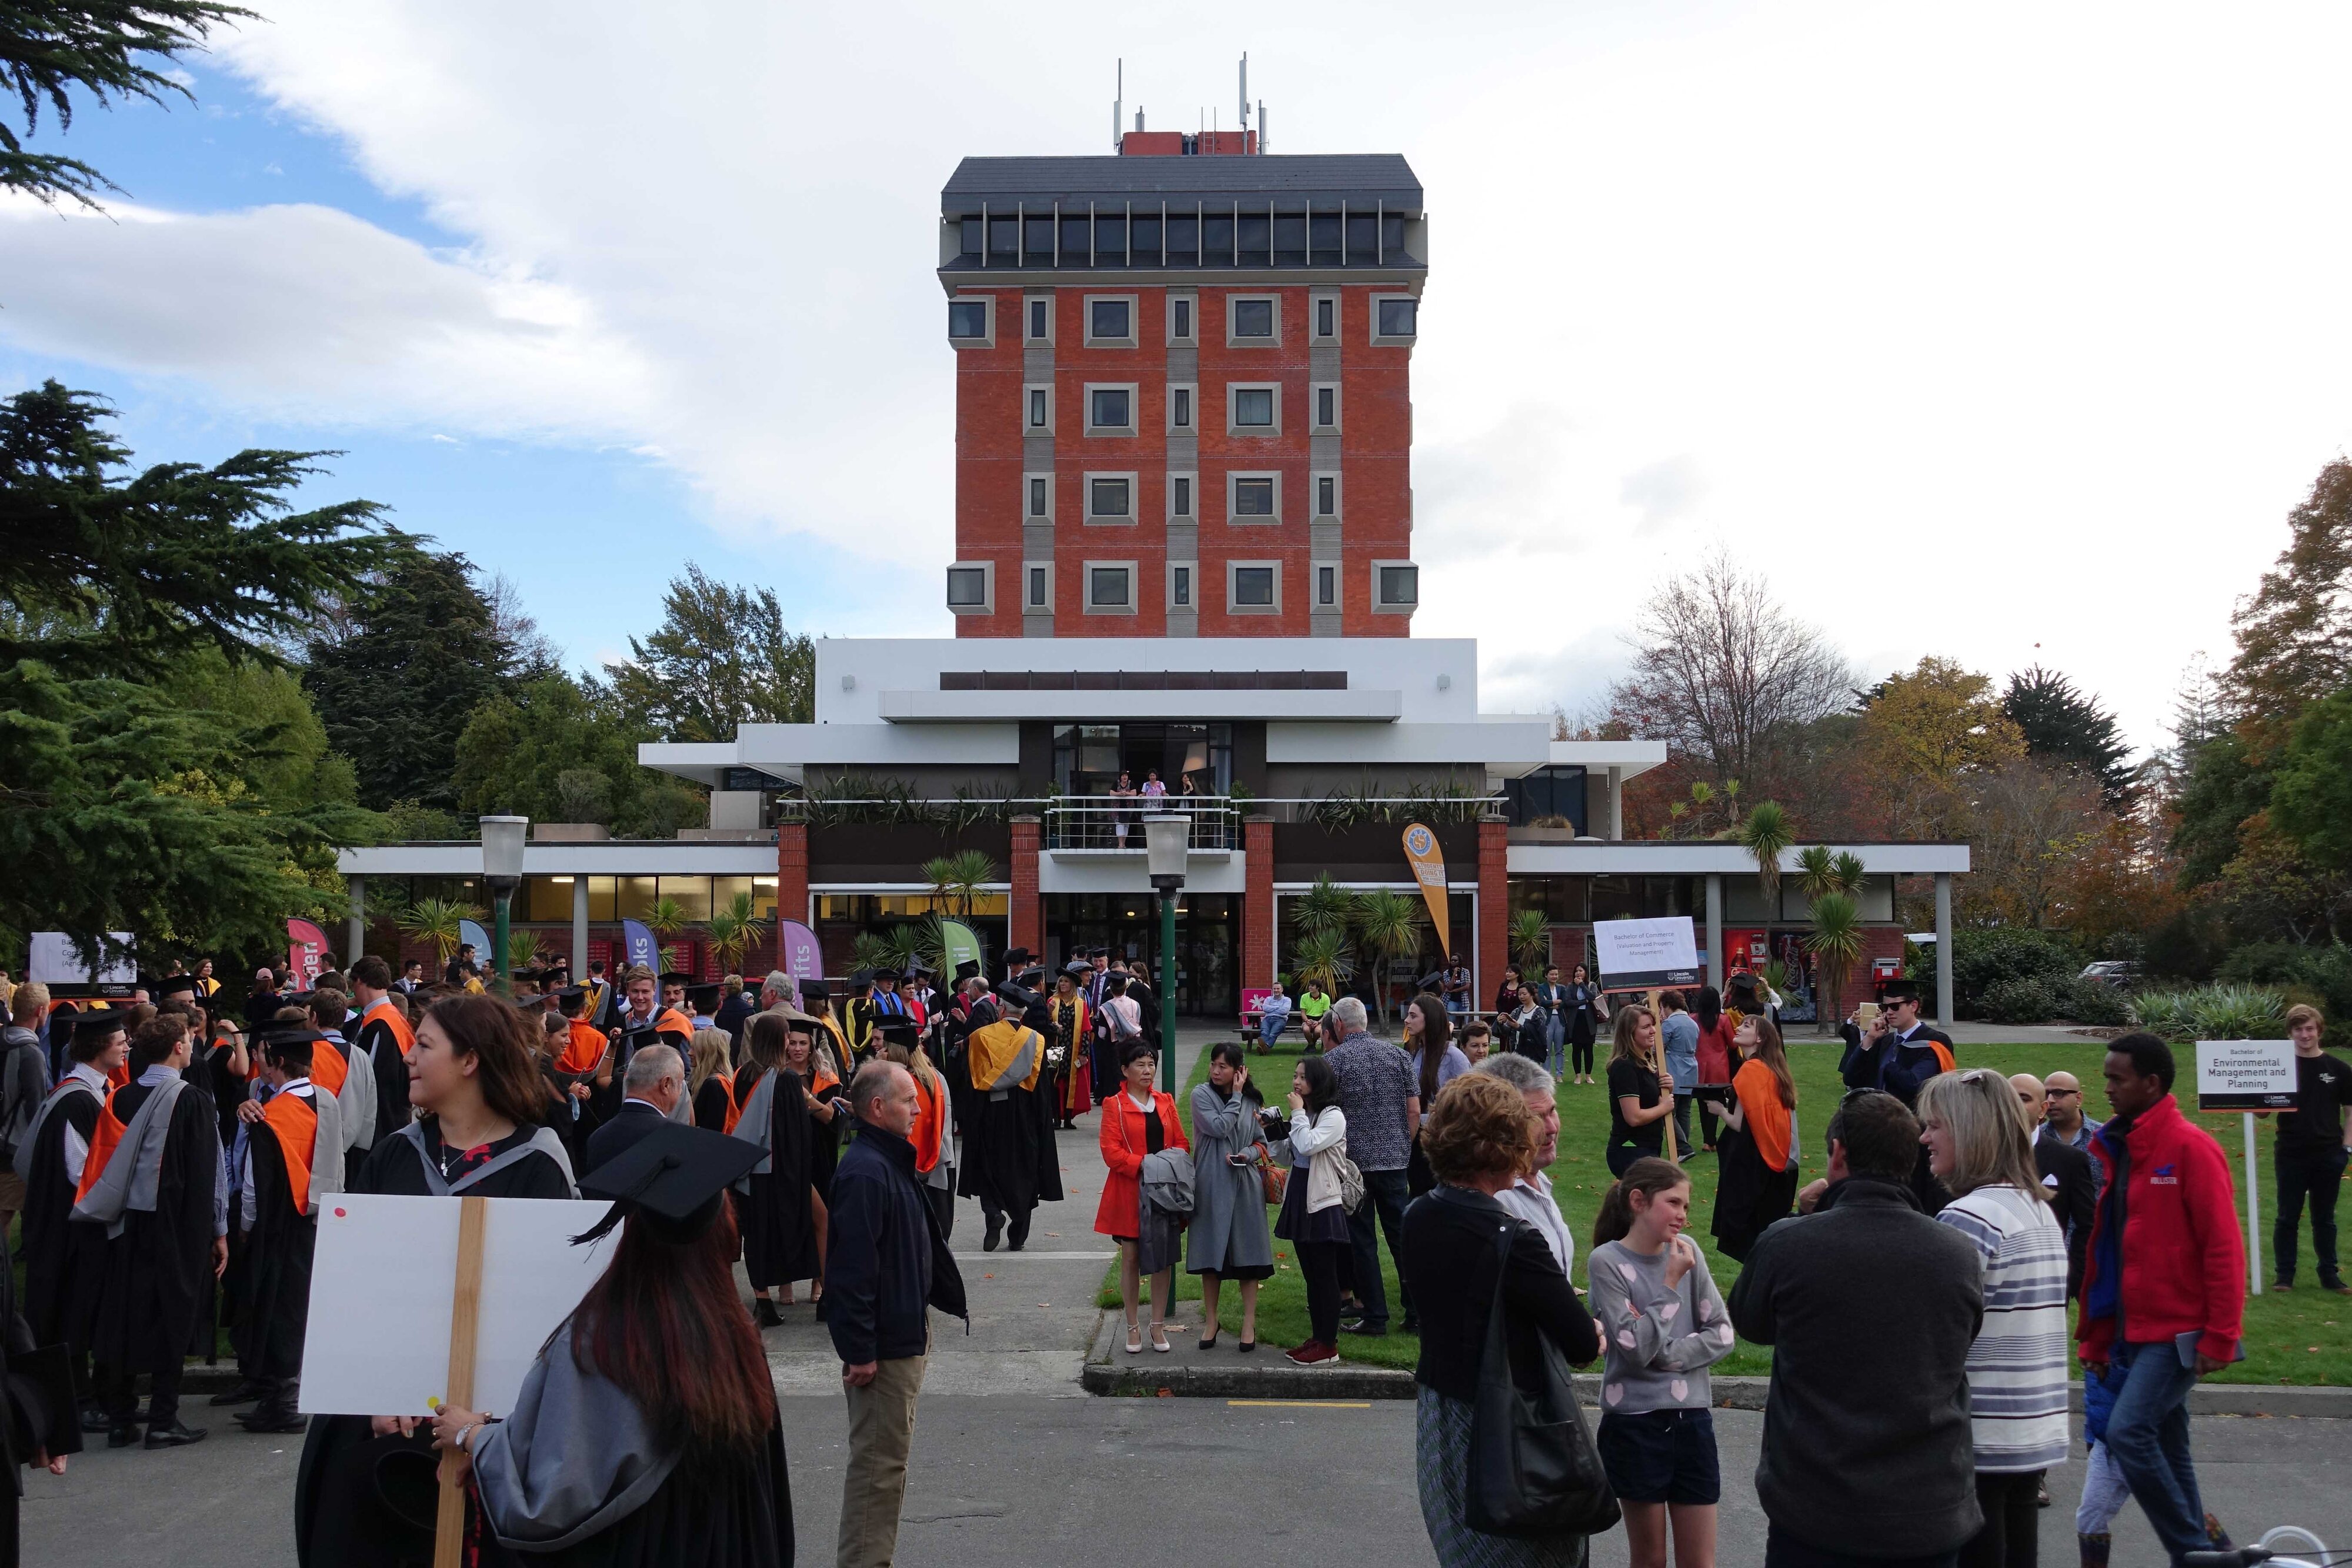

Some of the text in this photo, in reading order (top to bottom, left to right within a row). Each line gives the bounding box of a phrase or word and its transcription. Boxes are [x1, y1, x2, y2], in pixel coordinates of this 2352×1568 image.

[793, 945, 810, 978] ifts
[2213, 1058, 2280, 1067] Environmental
[2208, 1068, 2286, 1078] Management and
[2228, 1080, 2268, 1089] Planning
